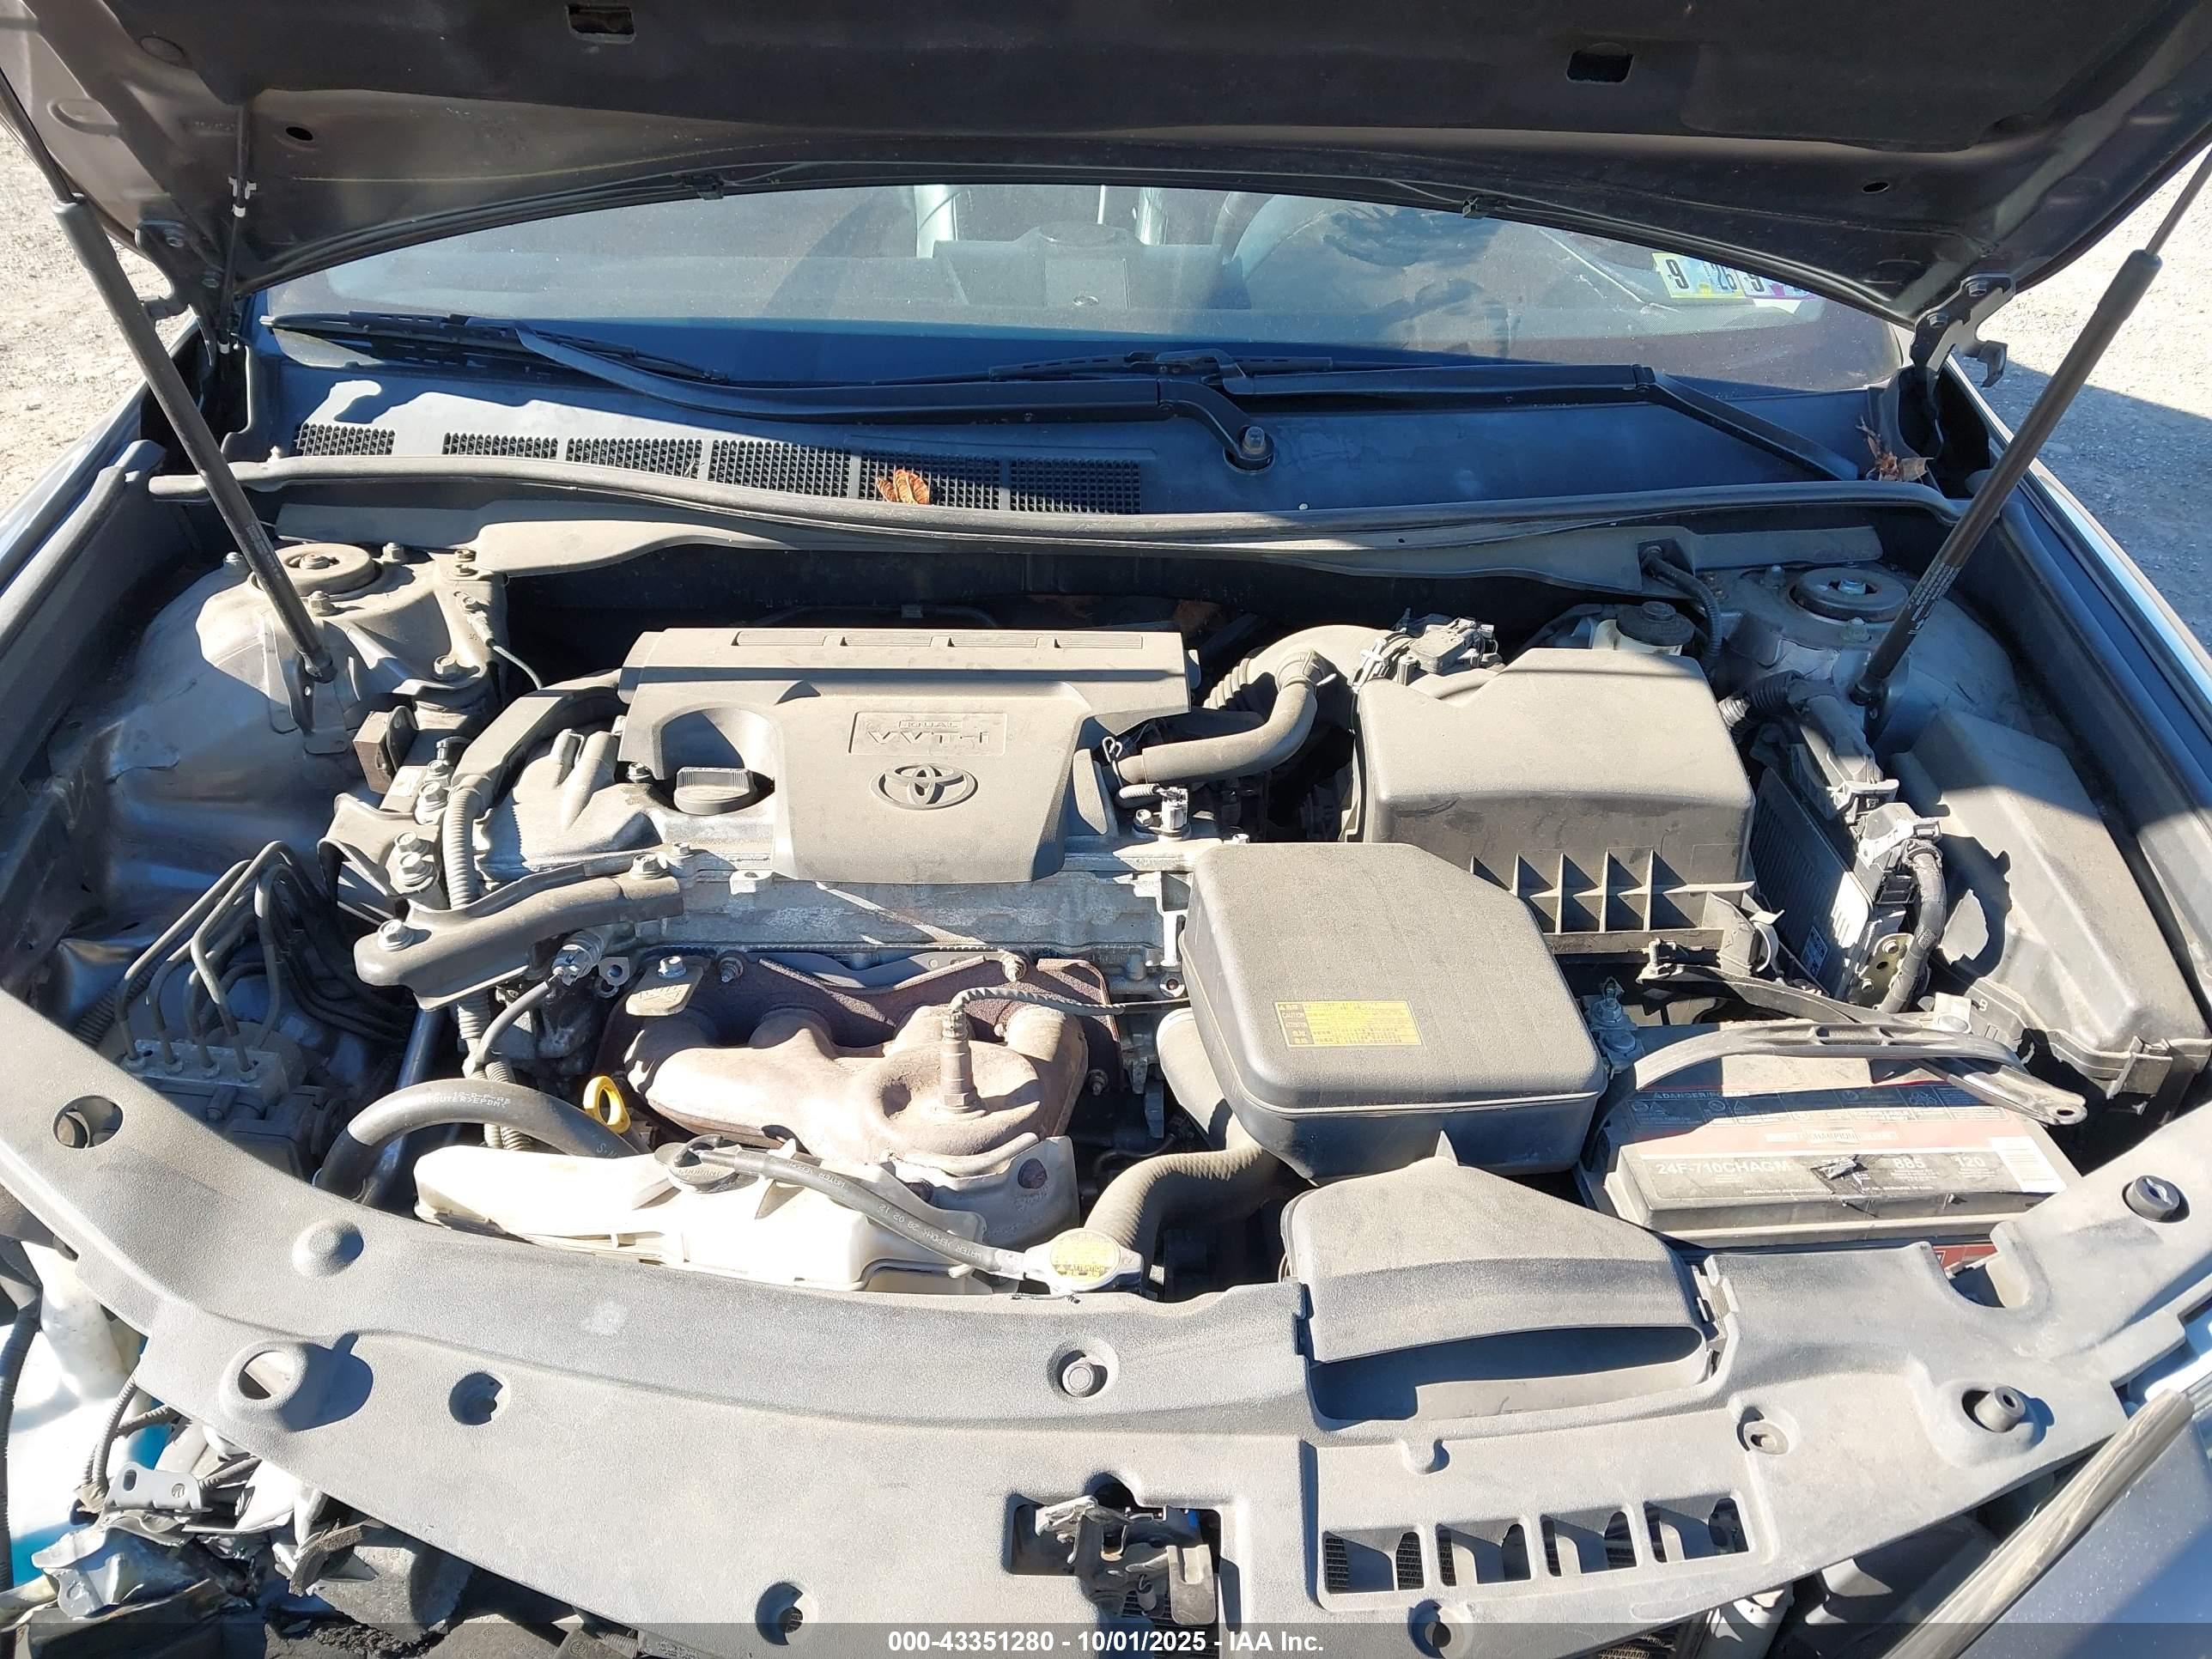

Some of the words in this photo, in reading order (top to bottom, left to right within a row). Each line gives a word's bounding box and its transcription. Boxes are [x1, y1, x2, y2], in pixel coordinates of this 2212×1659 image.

[1665, 259, 1689, 289] 9
[1711, 263, 1737, 290] 26
[1893, 1158, 1926, 1169] 885
[1954, 1156, 1985, 1167] 120
[955, 1244, 982, 1261] WATER
